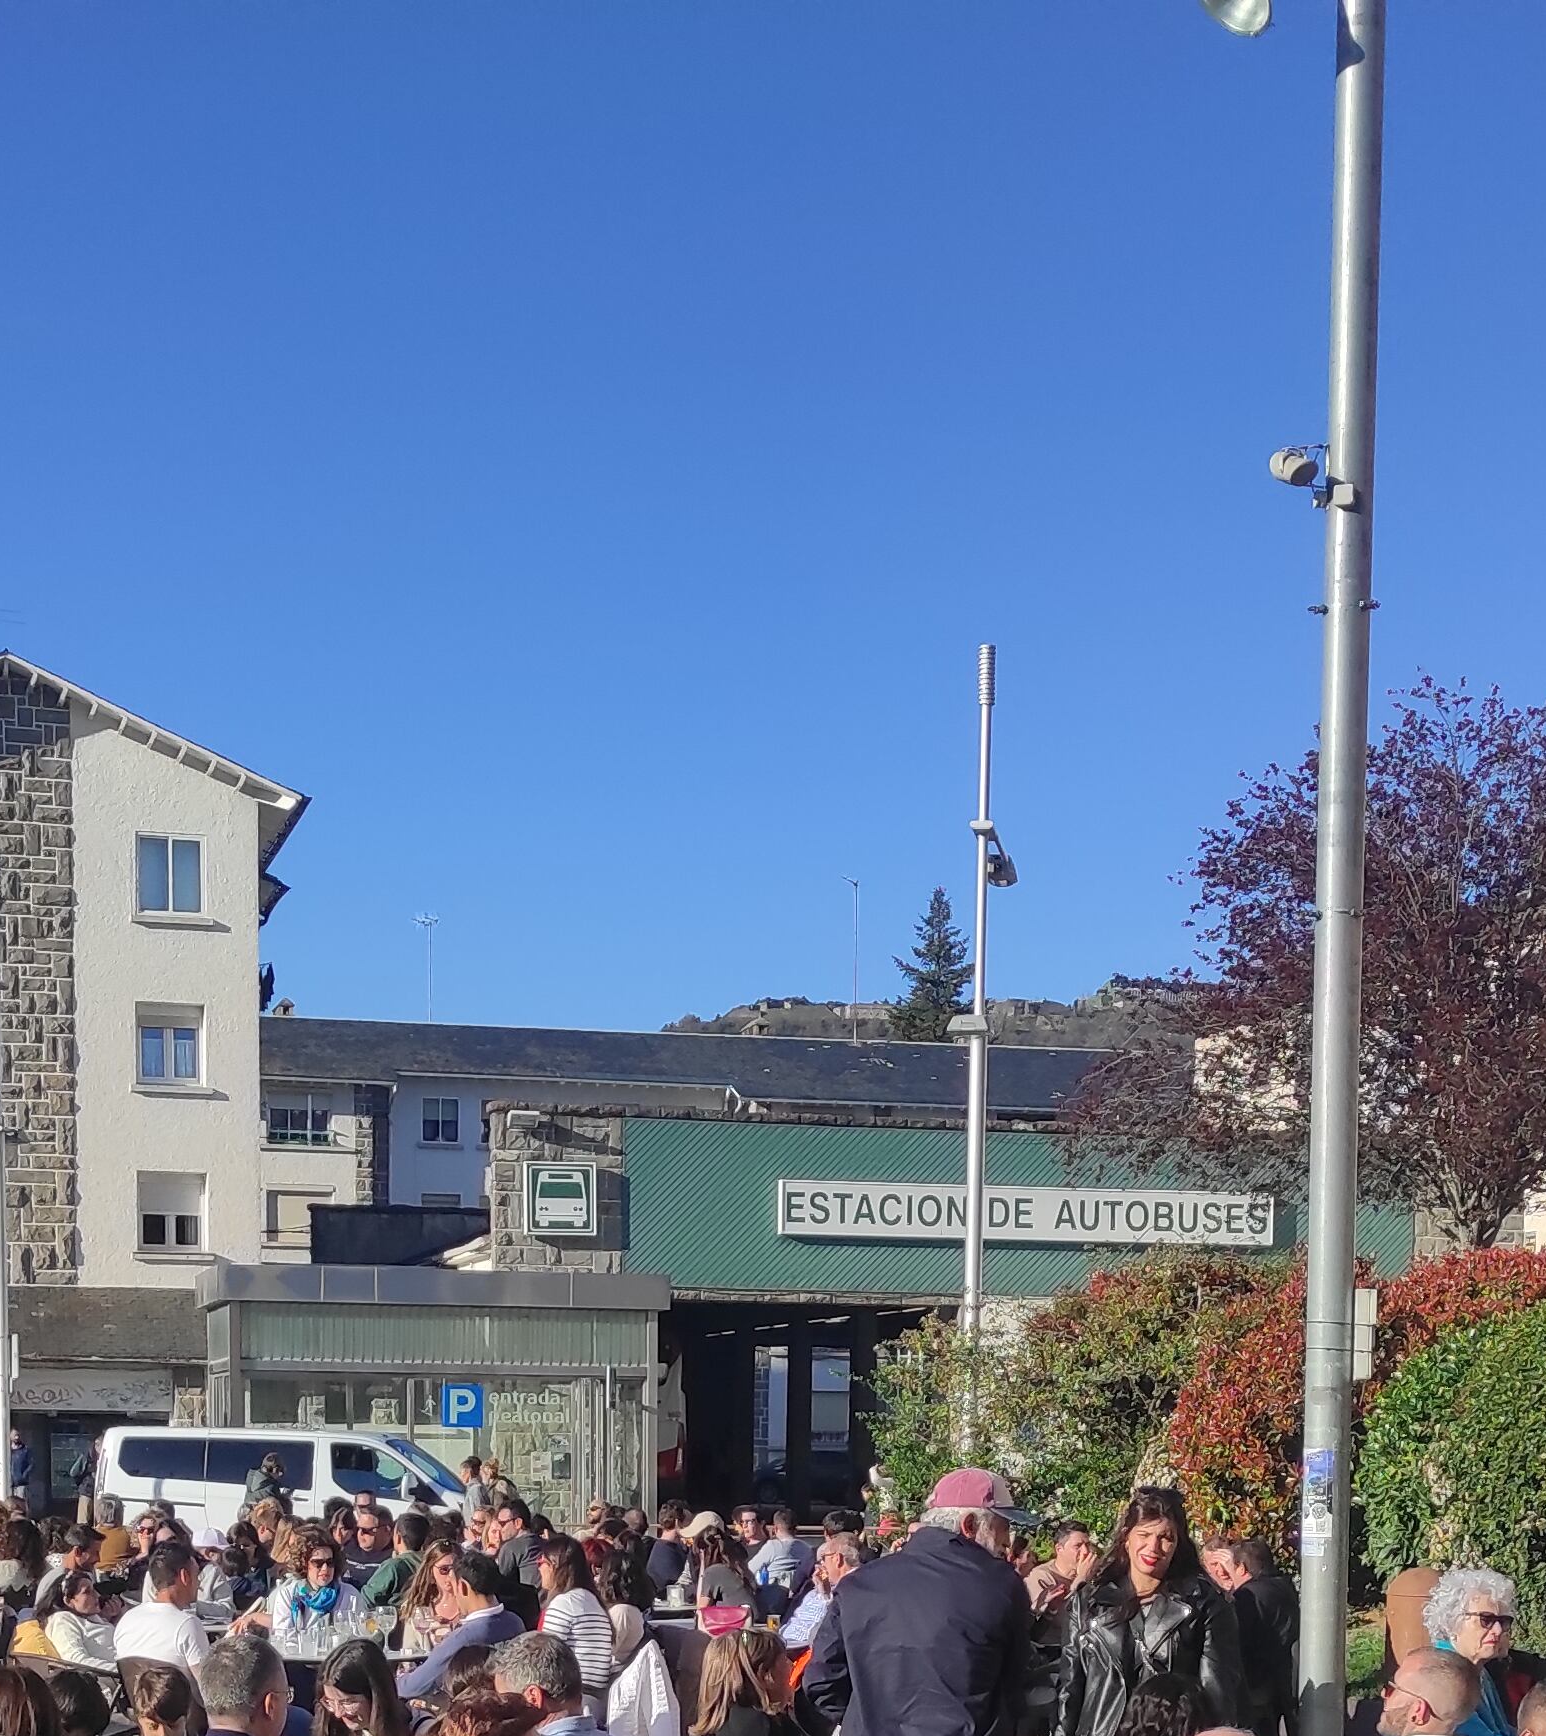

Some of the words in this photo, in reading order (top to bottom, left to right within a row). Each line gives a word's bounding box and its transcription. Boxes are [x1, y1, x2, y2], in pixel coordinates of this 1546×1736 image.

[786, 1191, 967, 1226] ESTACION
[988, 1197, 1034, 1229] DE
[1054, 1198, 1268, 1235] AUTOBUSES
[449, 1388, 476, 1424] P
[488, 1387, 561, 1405] entrada
[488, 1408, 570, 1427] peatonal
